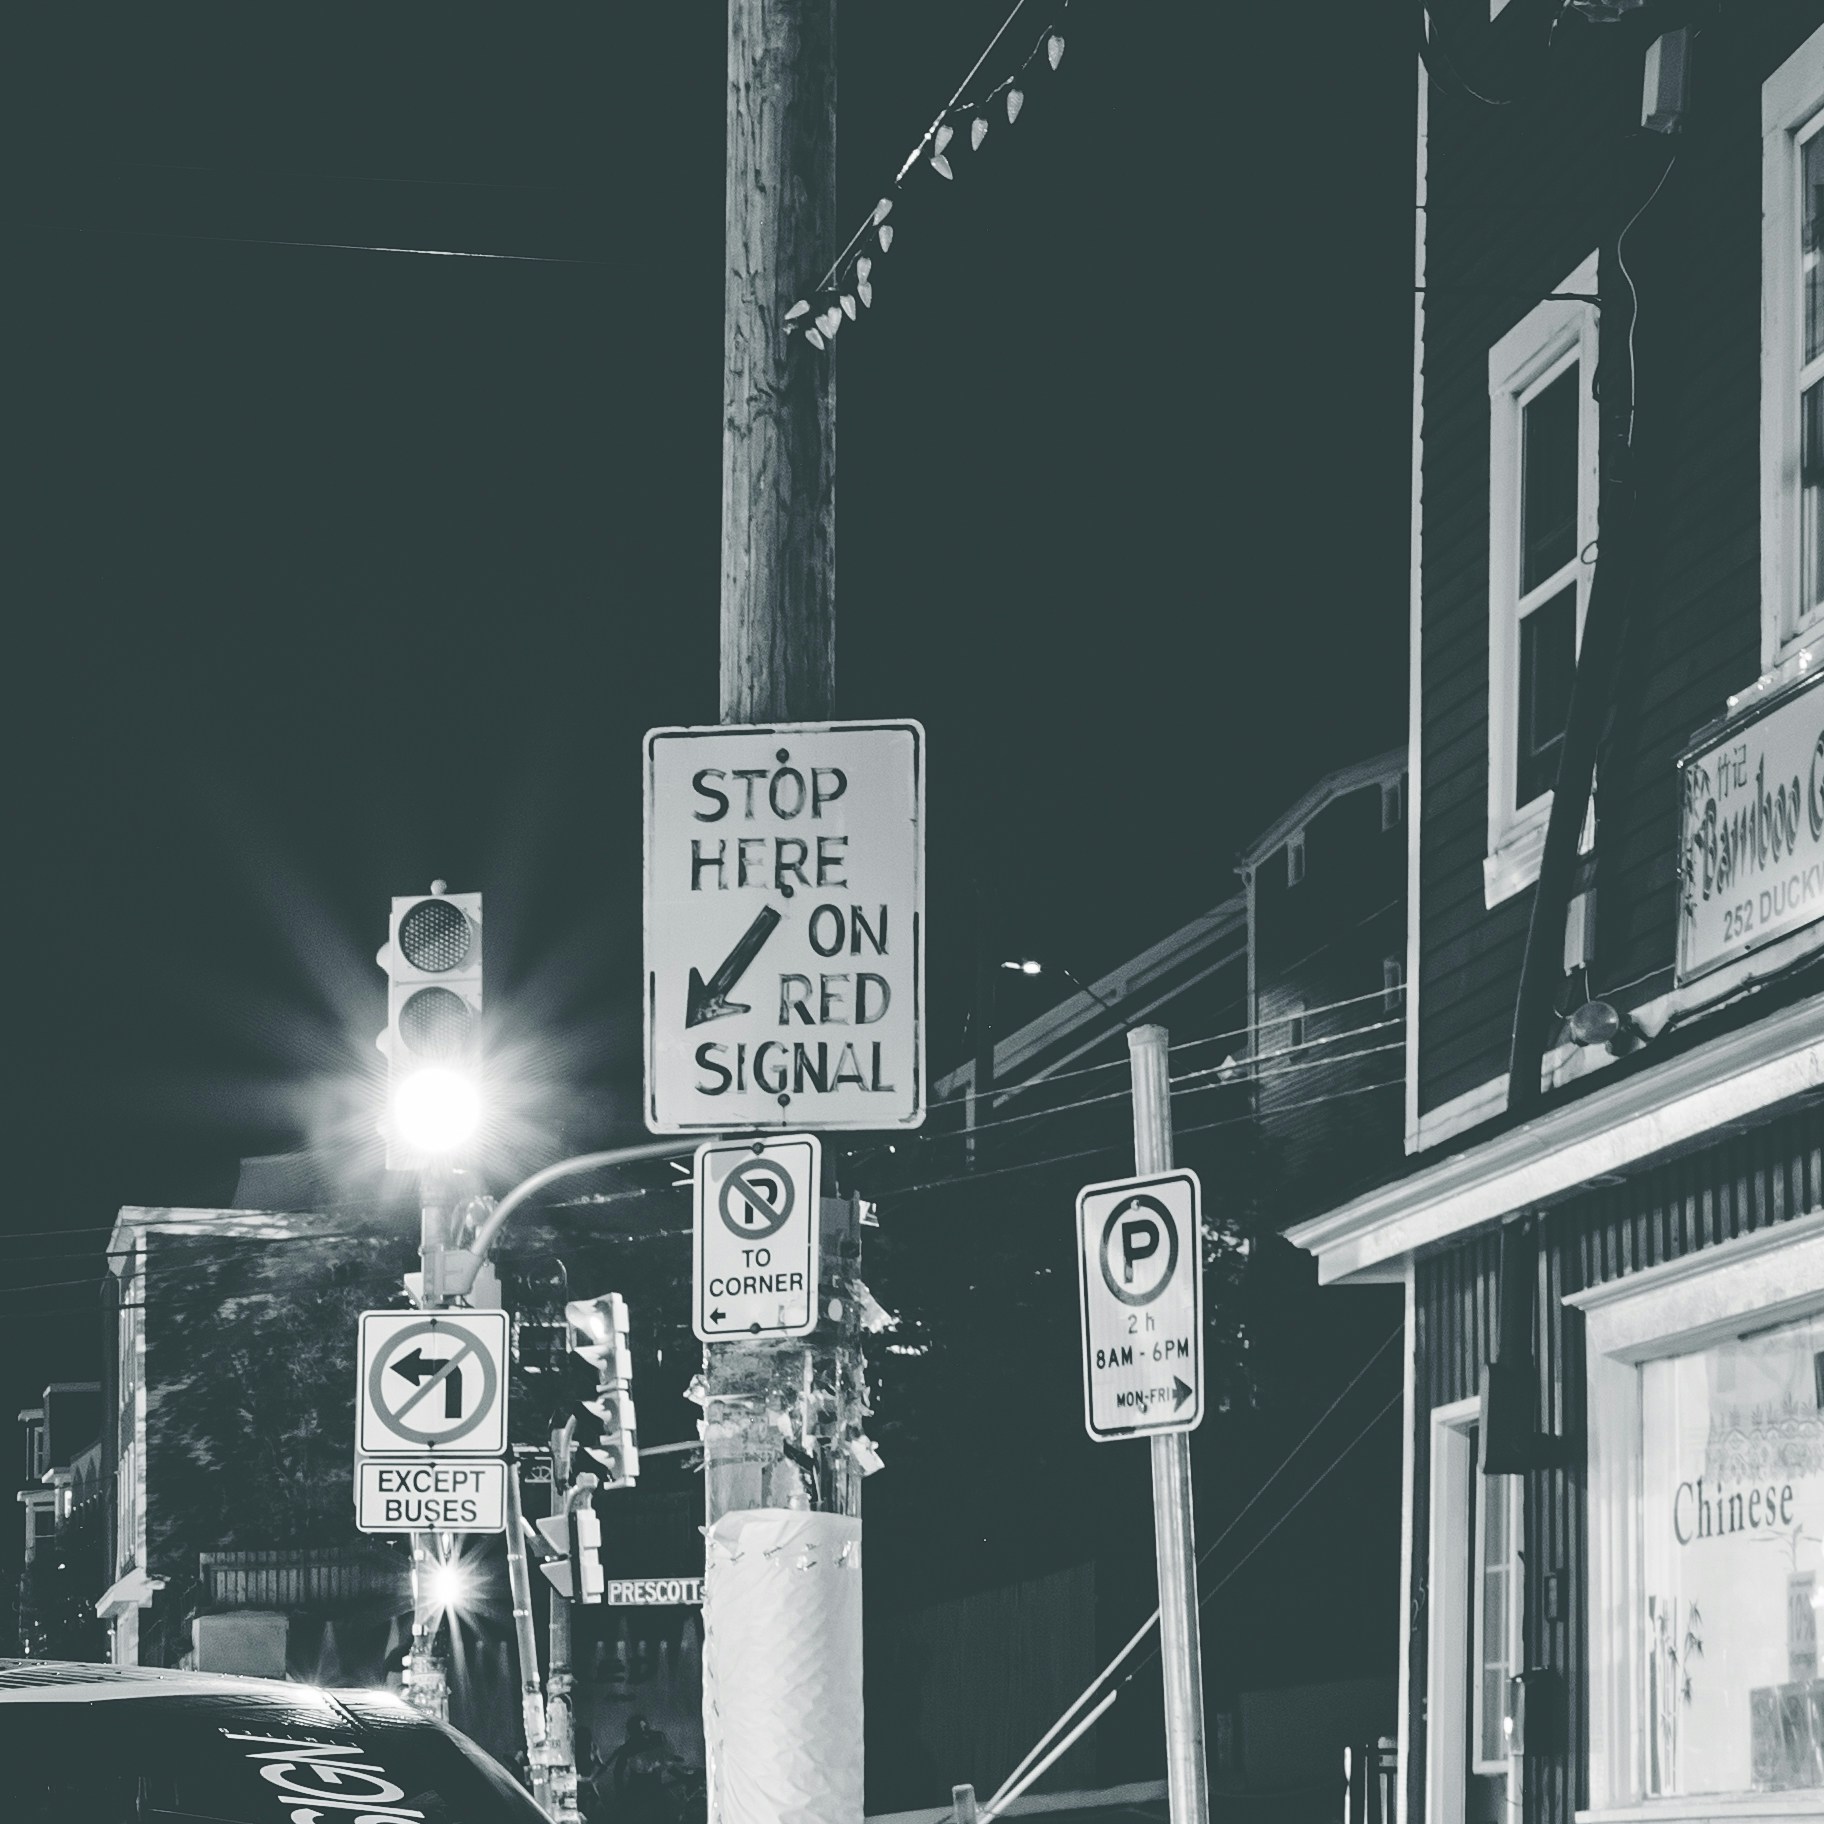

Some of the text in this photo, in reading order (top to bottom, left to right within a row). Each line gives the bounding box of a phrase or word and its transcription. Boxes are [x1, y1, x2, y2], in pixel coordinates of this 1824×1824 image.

[691, 766, 849, 822] STOP
[1699, 752, 1801, 901] Bamboo
[690, 836, 849, 891] HERE
[809, 903, 889, 957] ON
[1723, 899, 1753, 942] 252
[778, 973, 892, 1025] RED
[695, 1041, 895, 1096] SIGNAL
[741, 1248, 771, 1270] TO
[1122, 1220, 1159, 1283] P
[709, 1272, 803, 1297] CORNER
[1096, 1346, 1133, 1369] 8AM
[1153, 1338, 1189, 1361] 6PM
[378, 1470, 486, 1494] EXCEPT
[385, 1499, 477, 1522] BUSES
[1674, 1475, 1794, 1546] Chinese
[610, 1581, 700, 1603] PRESCOTT
